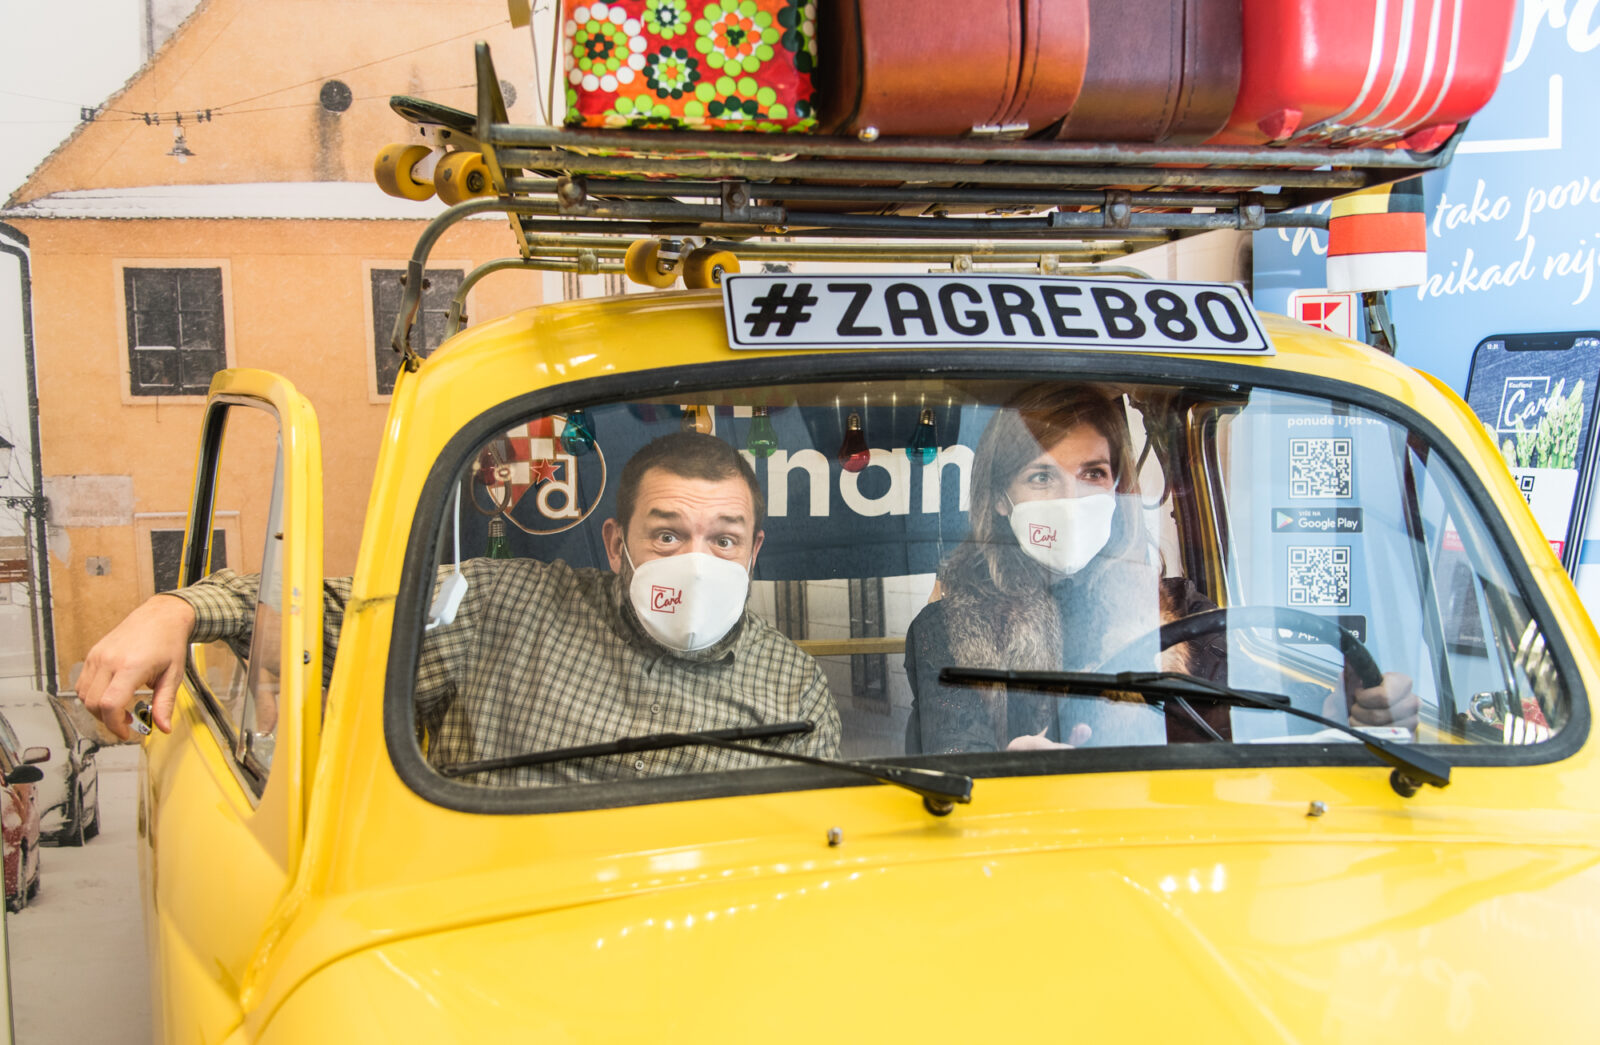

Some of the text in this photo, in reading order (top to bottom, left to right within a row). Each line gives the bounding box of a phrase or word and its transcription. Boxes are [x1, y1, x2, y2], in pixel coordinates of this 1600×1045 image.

[1433, 178, 1511, 238] tako
[1417, 232, 1600, 305] nikad nij
[744, 282, 1250, 344] #ZAGREB80
[1504, 377, 1566, 427] Card
[1032, 529, 1057, 543] Card
[1298, 517, 1358, 531] Google Play
[654, 589, 683, 609] Card
